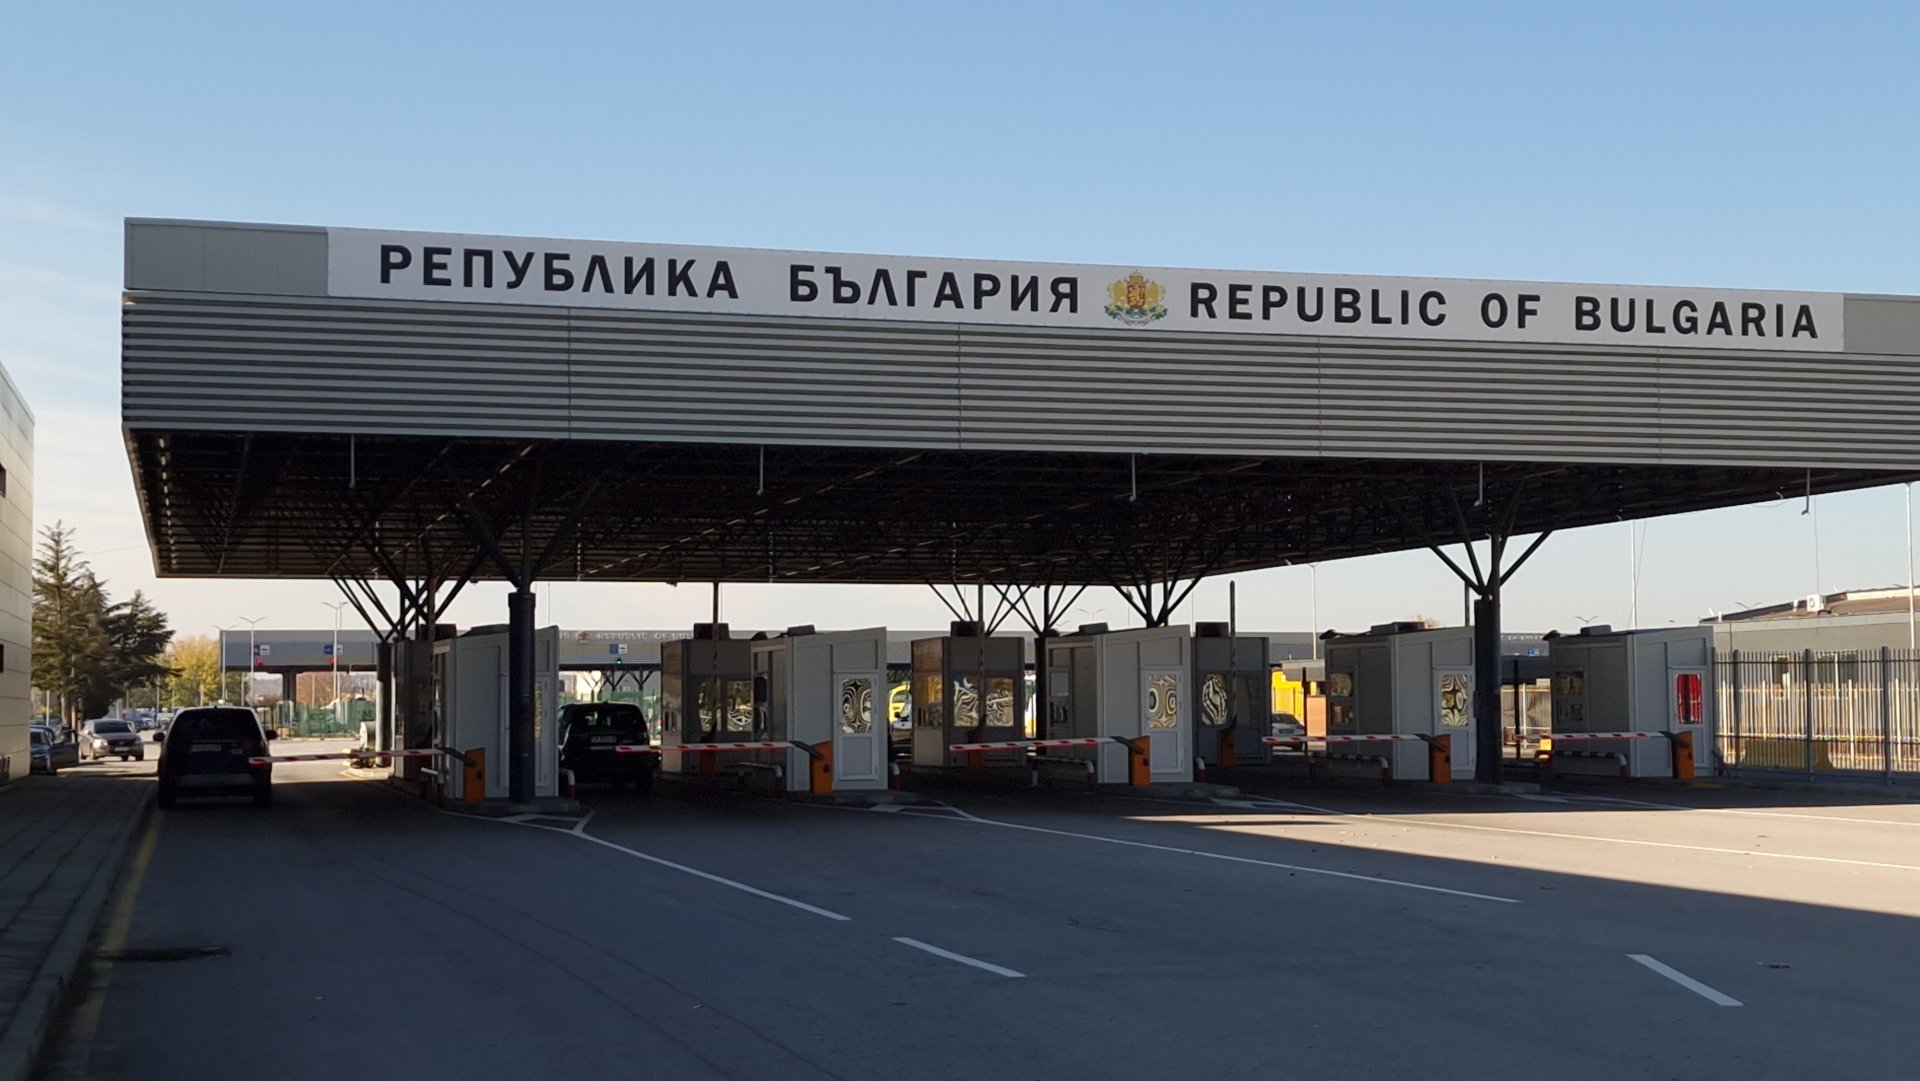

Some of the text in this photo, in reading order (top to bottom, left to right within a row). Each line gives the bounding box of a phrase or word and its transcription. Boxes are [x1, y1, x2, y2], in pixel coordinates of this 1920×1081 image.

[380, 244, 1078, 314] РЕПУБЛИКА БЪЛГАРИЯ
[1190, 282, 1818, 339] REPUBLIC OF BULGARIA
